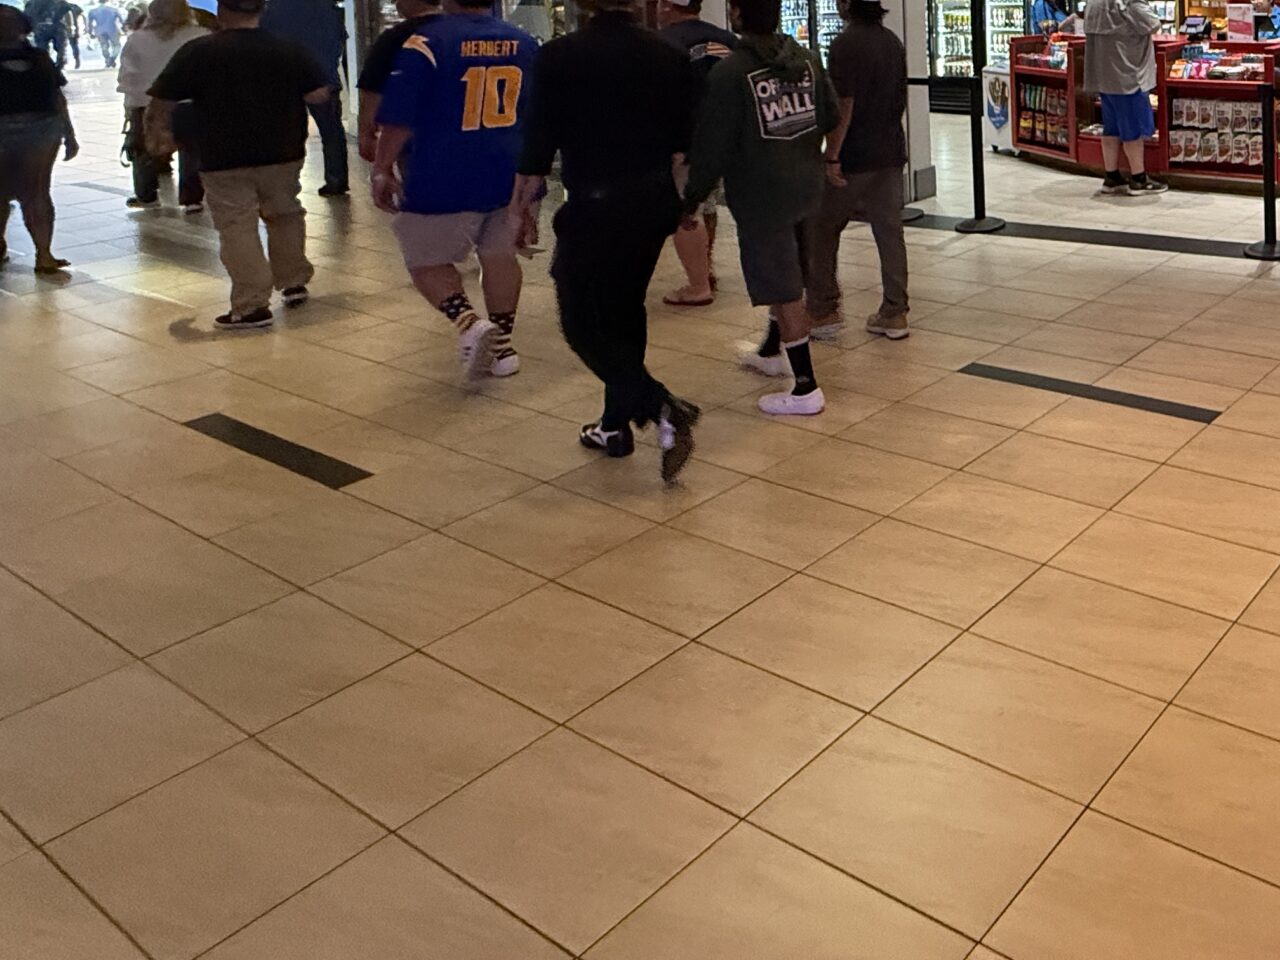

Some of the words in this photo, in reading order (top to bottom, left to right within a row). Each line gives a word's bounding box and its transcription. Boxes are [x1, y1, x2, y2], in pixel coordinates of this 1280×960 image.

[461, 40, 519, 57] HERBERT
[461, 65, 522, 131] 10
[761, 92, 815, 121] WALL
